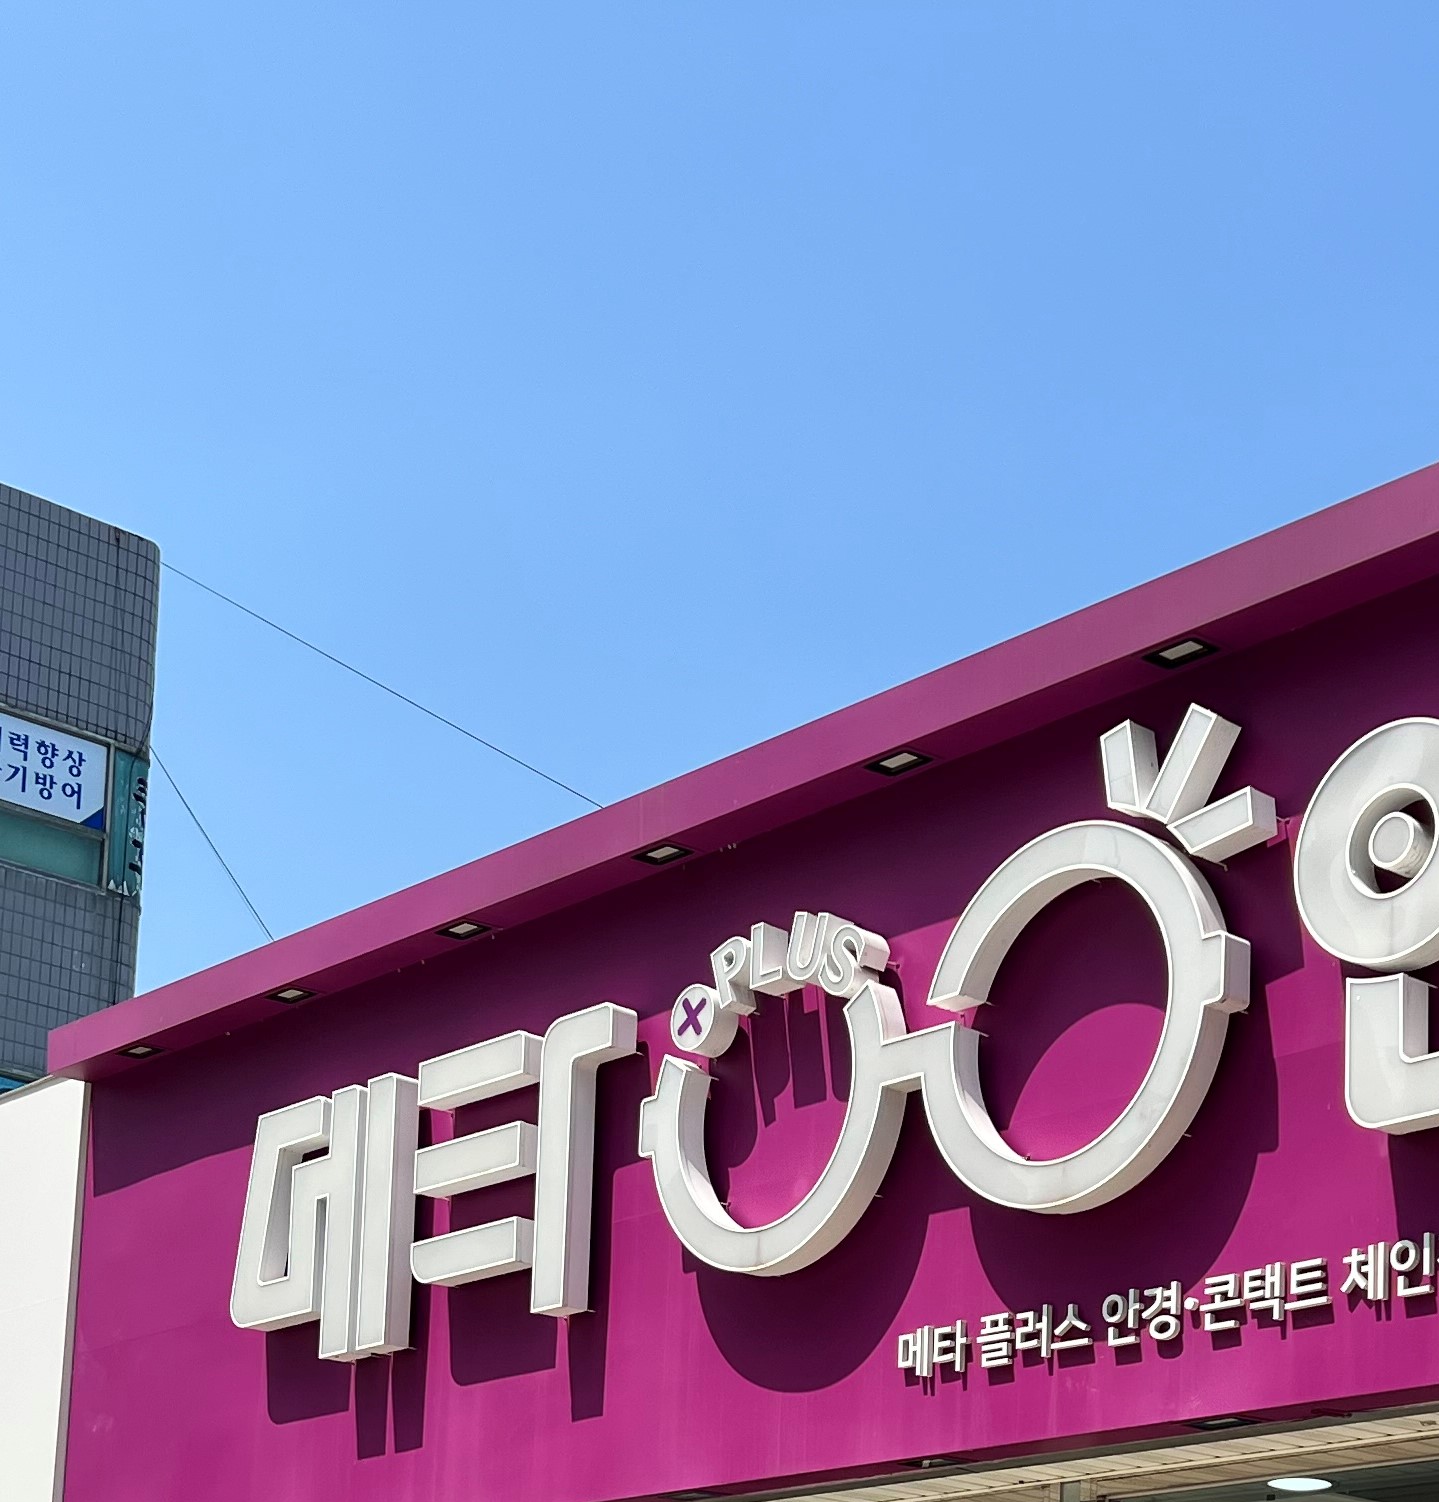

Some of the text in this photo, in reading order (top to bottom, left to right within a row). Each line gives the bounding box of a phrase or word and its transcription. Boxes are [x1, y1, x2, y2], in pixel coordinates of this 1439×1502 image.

[0, 727, 86, 777] 력향상
[0, 763, 82, 810] 기방어
[710, 911, 890, 1015] PLUS
[230, 1001, 639, 1362] 메타
[897, 1319, 967, 1378] 메타
[975, 1304, 1093, 1369] 플러스
